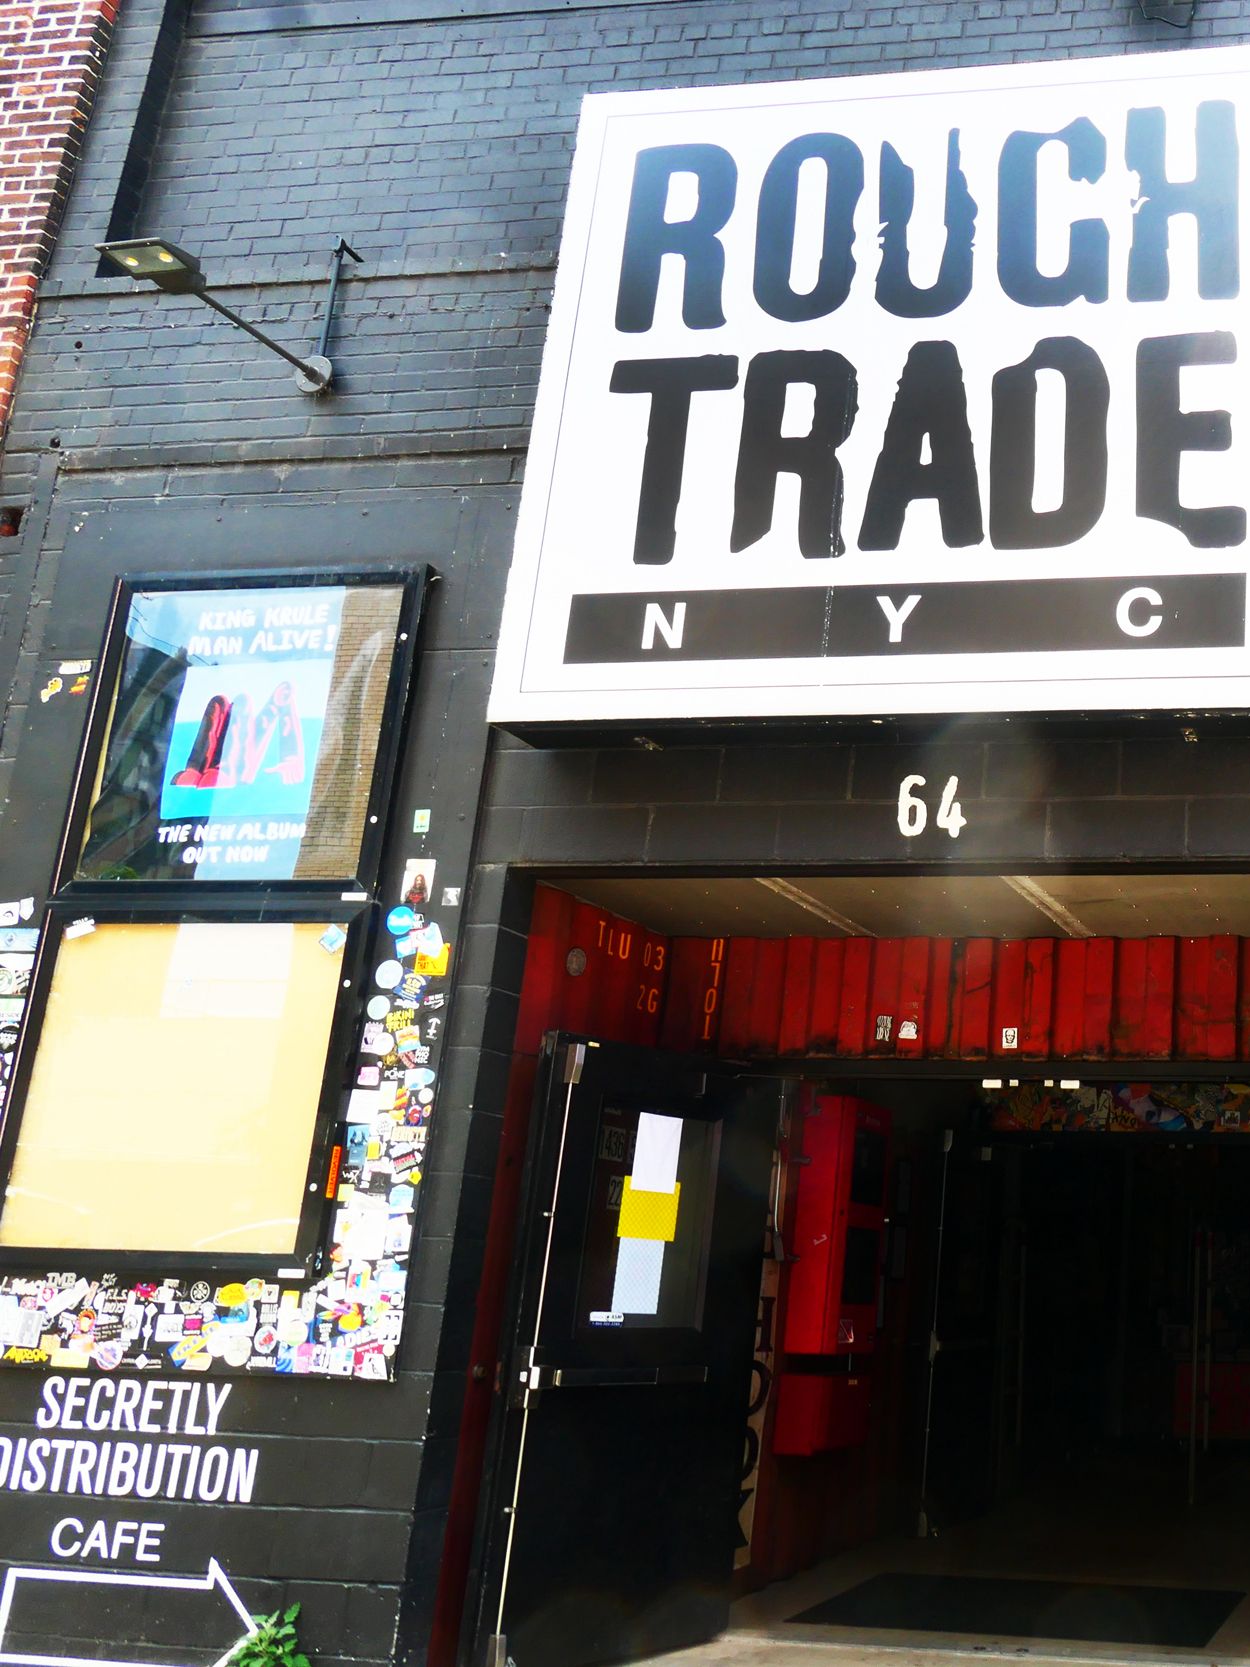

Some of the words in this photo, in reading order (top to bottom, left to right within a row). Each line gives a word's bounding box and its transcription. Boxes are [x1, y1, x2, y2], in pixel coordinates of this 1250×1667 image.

[615, 99, 1240, 333] ROUGH
[609, 331, 1247, 565] TRADE
[199, 609, 256, 632] KING
[264, 603, 329, 629] KRULE
[188, 632, 243, 656] MAN
[249, 625, 336, 654] ALIVE!
[898, 775, 967, 838] 64
[158, 826, 190, 844] THE
[194, 823, 237, 843] NEW
[239, 822, 307, 841] ALBUM
[183, 845, 222, 864] OUT
[227, 845, 270, 864] NOW
[36, 1375, 232, 1435] SECRETLY
[51, 1517, 165, 1562] CAFE
